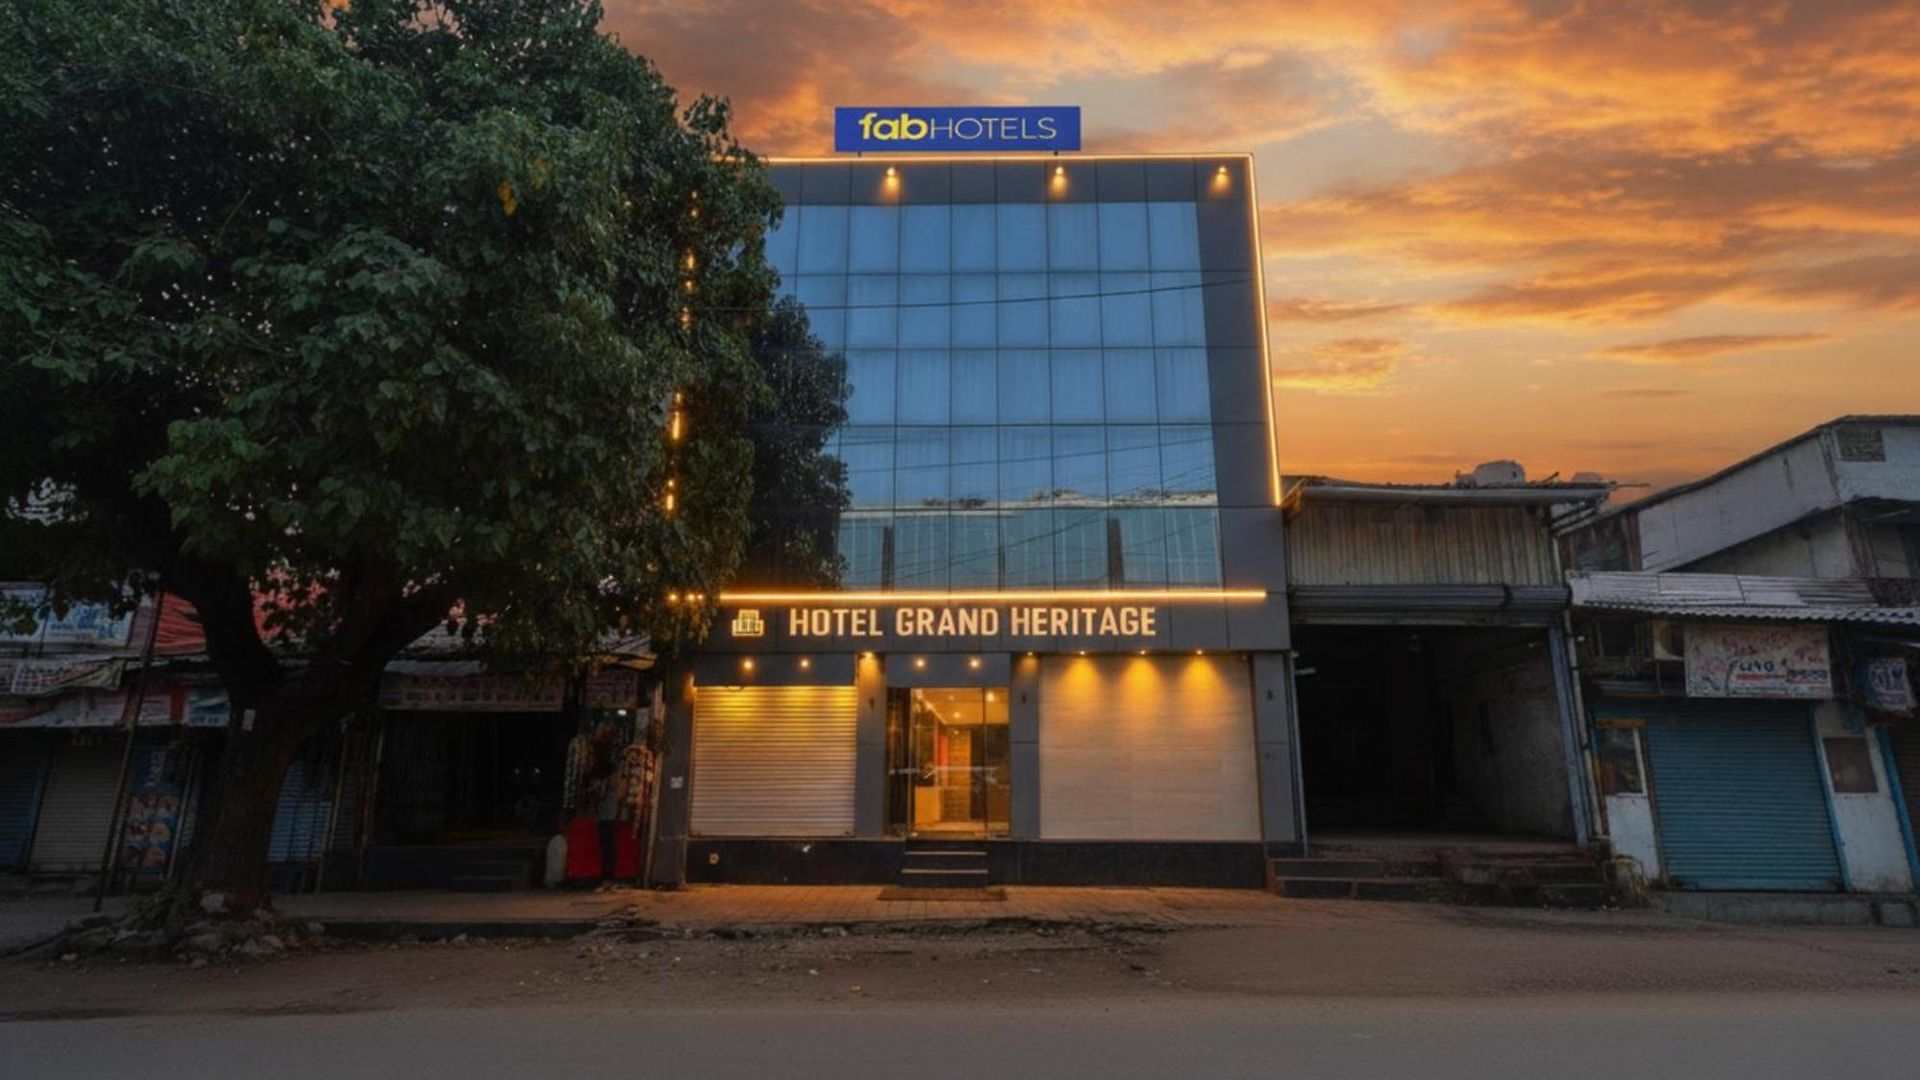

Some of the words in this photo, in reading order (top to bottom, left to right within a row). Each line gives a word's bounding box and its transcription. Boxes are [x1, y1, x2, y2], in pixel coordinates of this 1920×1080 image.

[858, 112, 1057, 141] fabHOTELS
[789, 608, 883, 636] HOTEL
[895, 607, 999, 636] GRAND
[1010, 606, 1157, 636] HERITAGE
